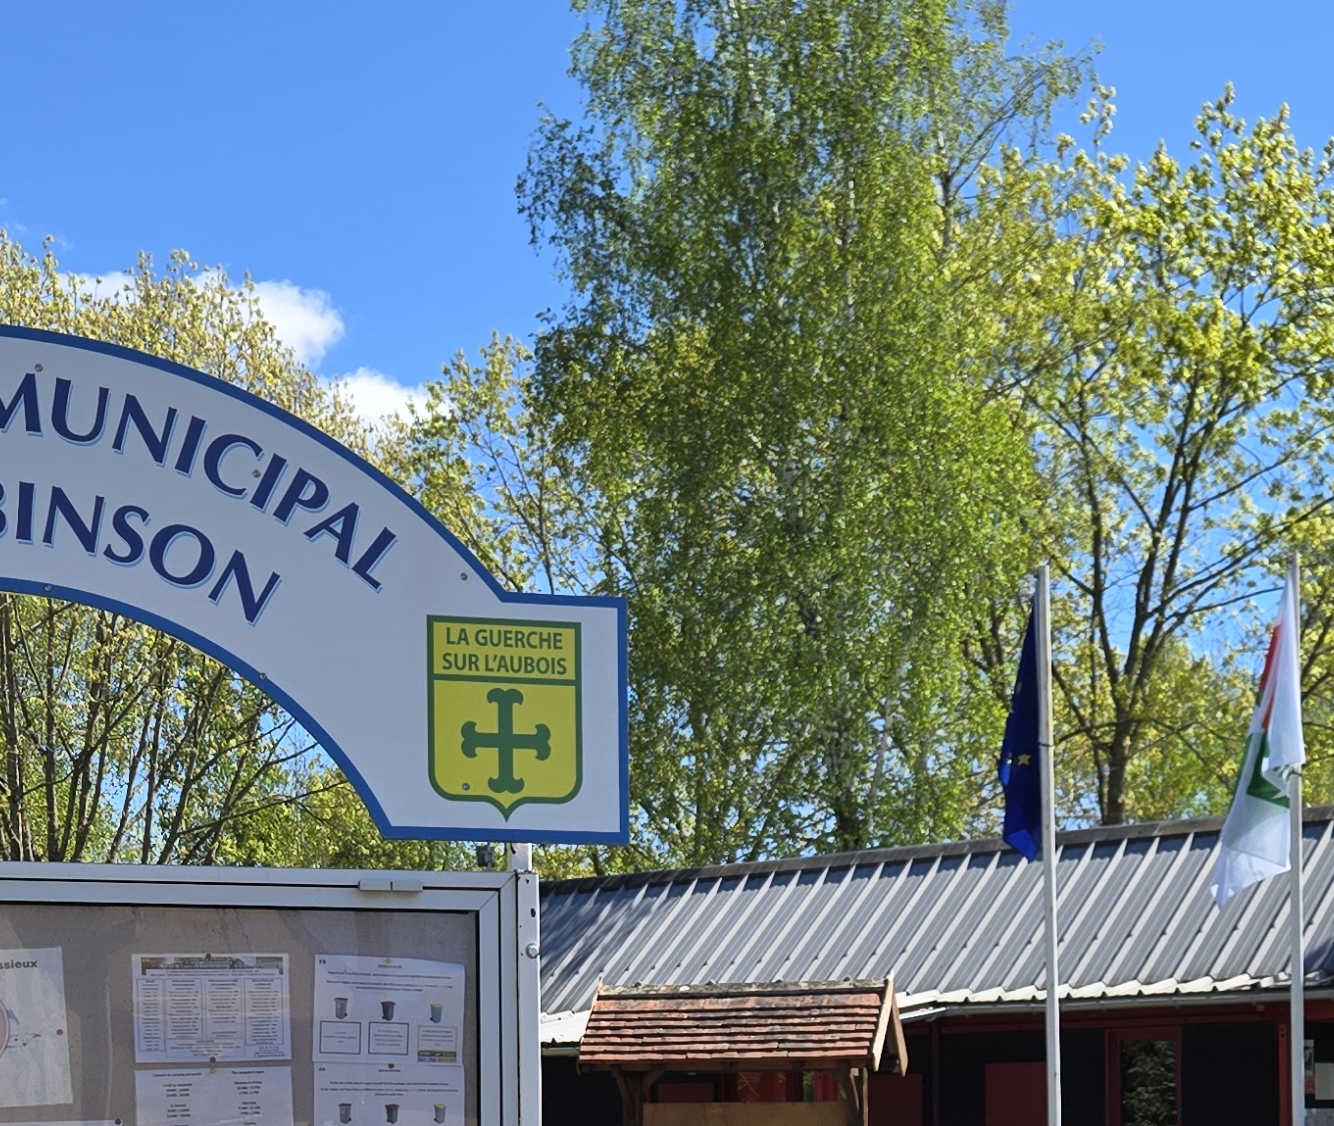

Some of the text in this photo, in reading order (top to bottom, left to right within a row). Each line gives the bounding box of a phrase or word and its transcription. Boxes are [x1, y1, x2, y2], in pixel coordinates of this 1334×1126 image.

[446, 627, 563, 650] LA GUERCHE
[442, 652, 567, 675] SUR L'AUBOIS
